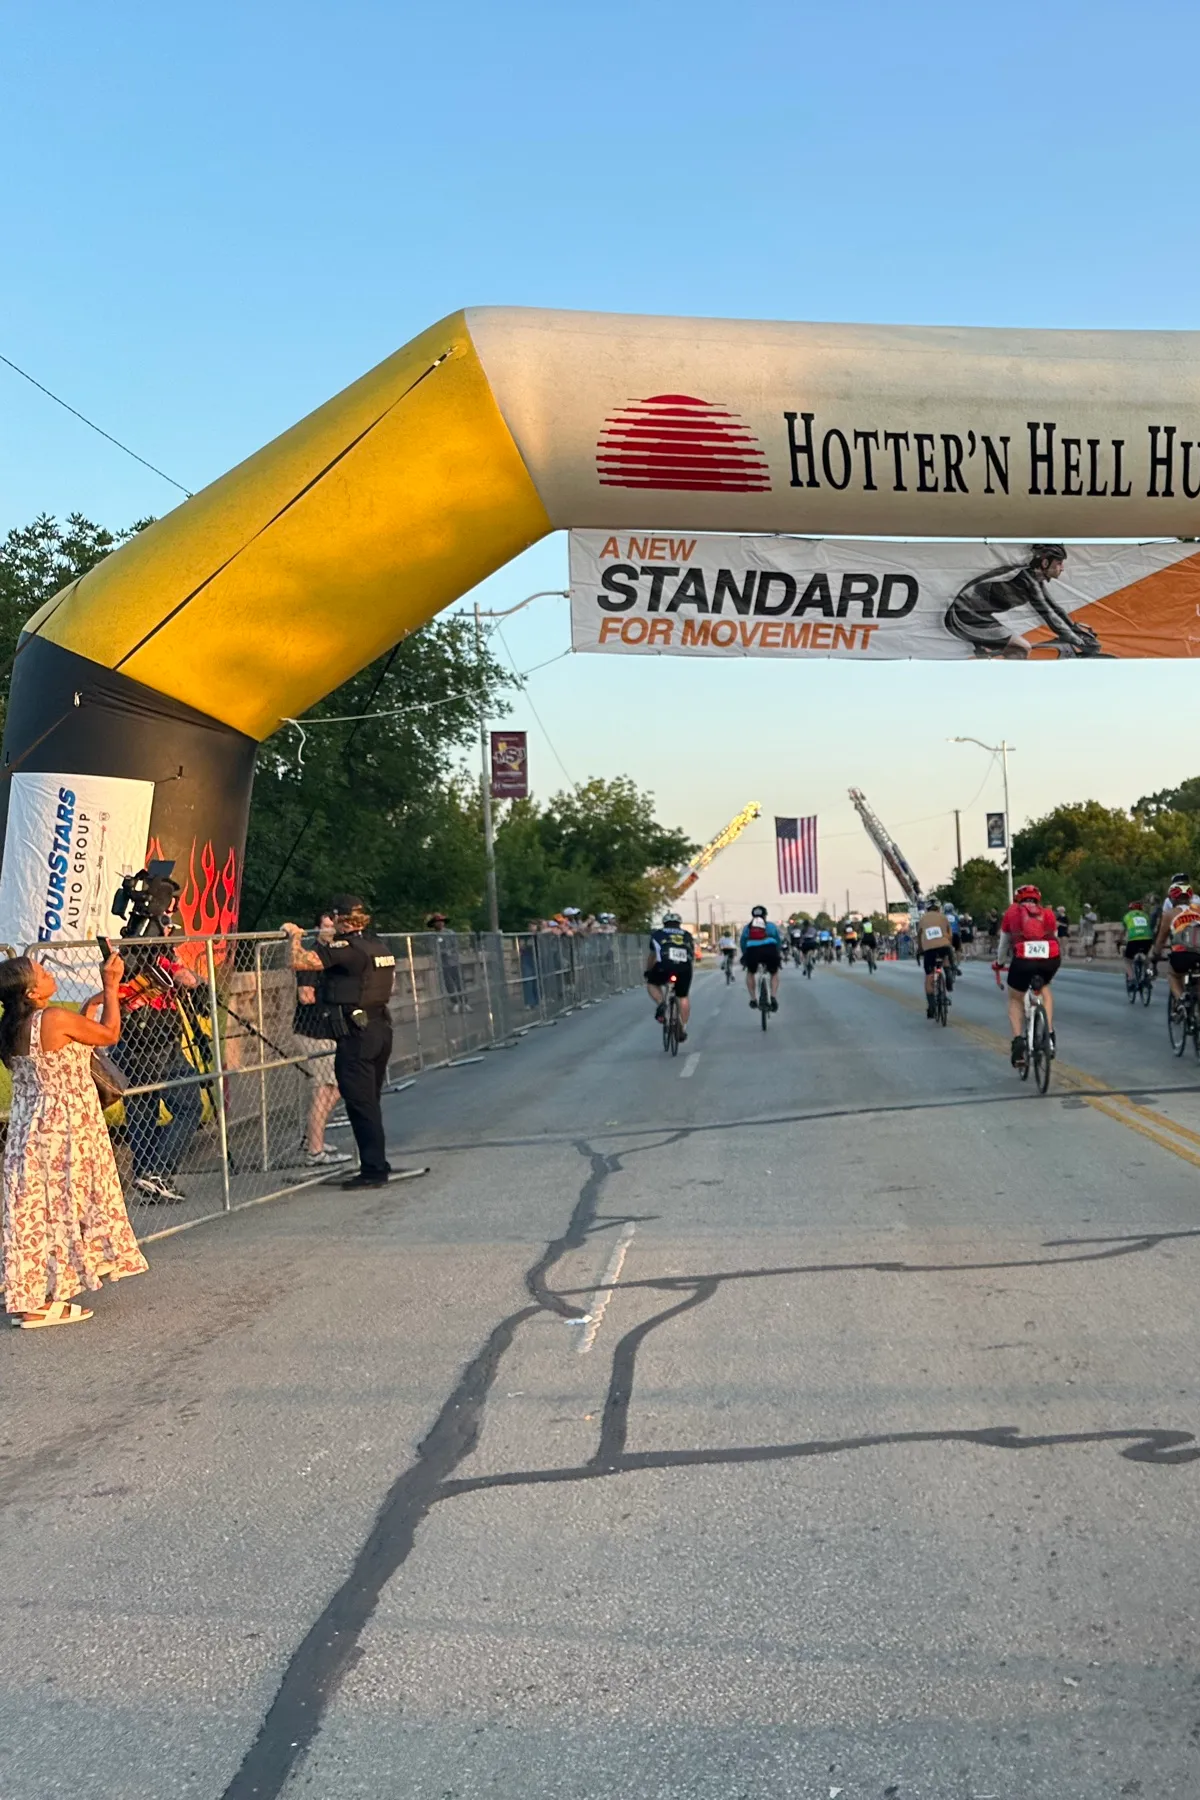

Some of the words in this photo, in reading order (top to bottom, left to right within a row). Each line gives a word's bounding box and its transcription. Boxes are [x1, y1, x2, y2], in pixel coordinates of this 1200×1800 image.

[784, 412, 1010, 495] HOTTER'N
[1027, 422, 1132, 498] HELL
[599, 536, 620, 559] A
[627, 538, 697, 561] NEW
[597, 564, 919, 619] STANDARD
[598, 617, 674, 645] FOR
[680, 619, 879, 650] MOVEMENT
[74, 813, 90, 873] GROUP
[68, 882, 83, 929] AUTO
